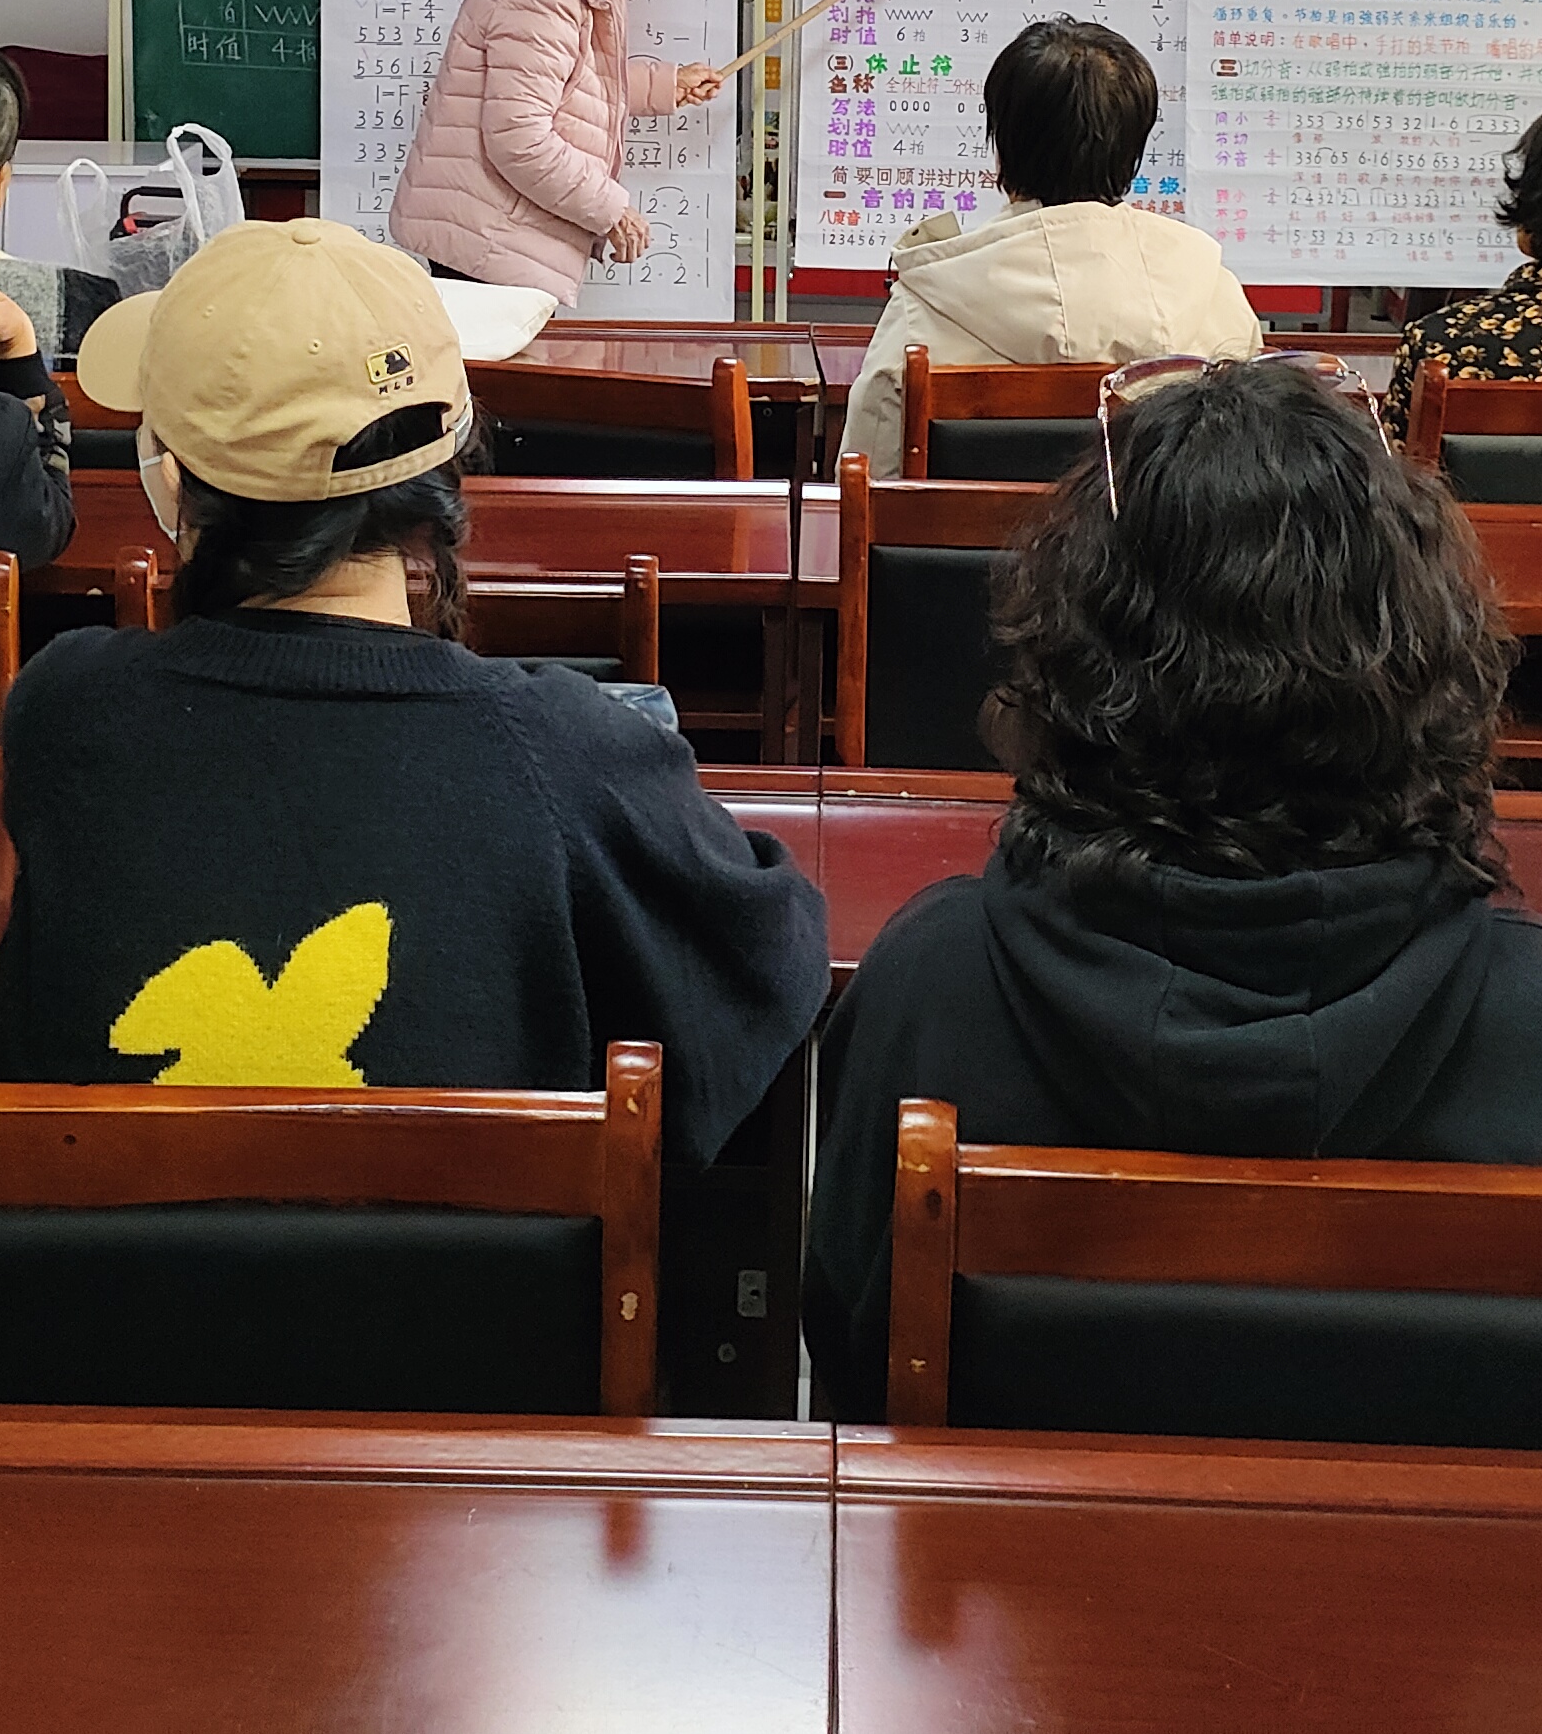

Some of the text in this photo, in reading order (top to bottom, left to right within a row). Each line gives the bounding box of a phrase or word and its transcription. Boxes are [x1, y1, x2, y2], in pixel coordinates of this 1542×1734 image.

[827, 6, 876, 25] 划拍
[829, 26, 877, 46] 时值
[865, 53, 953, 76] 休止符
[828, 73, 875, 94] 名称
[832, 98, 876, 116] 写法
[827, 118, 876, 138] 划拍
[827, 138, 873, 159] 时值
[861, 187, 978, 212] 音的高低
